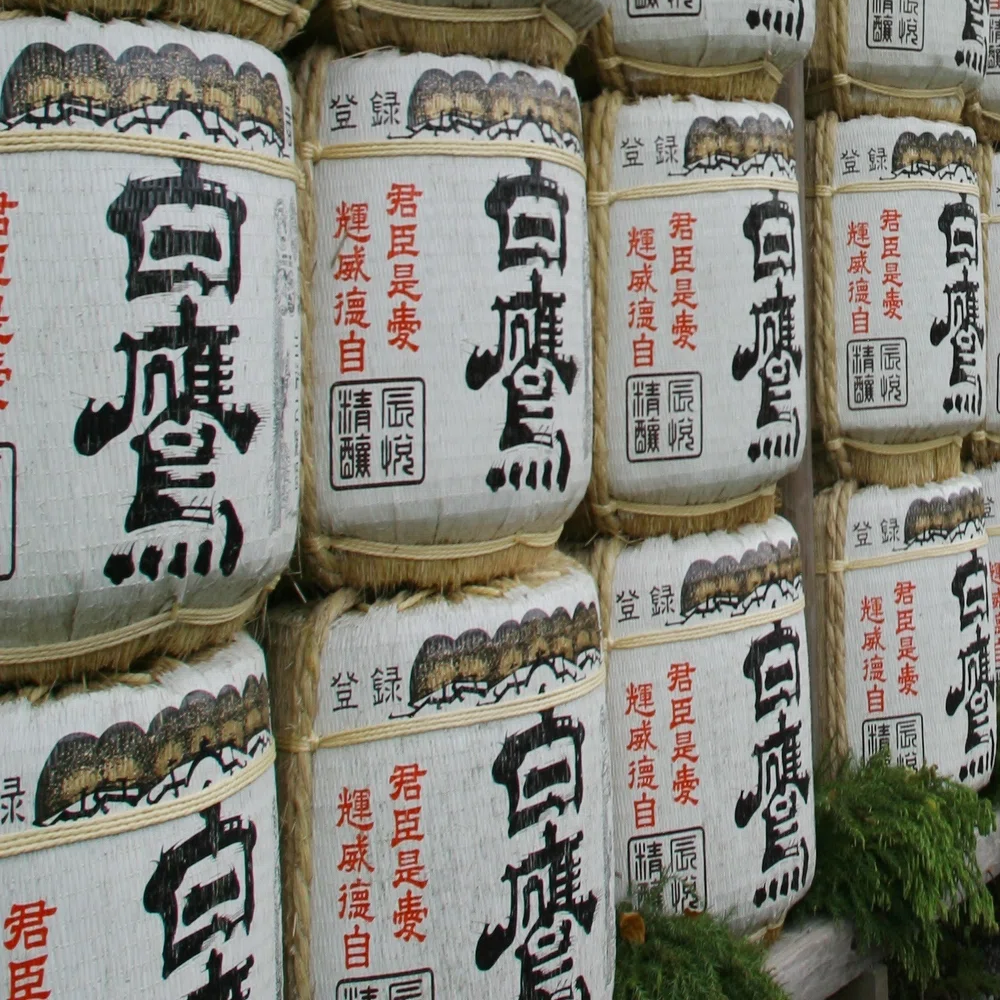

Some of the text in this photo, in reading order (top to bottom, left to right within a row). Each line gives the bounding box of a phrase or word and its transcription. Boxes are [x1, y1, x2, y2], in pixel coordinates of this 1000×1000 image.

[74, 133, 261, 586] 白鷹
[465, 150, 579, 493] 白鷹
[731, 187, 803, 464] 白鷹
[735, 612, 809, 908] 白鷹
